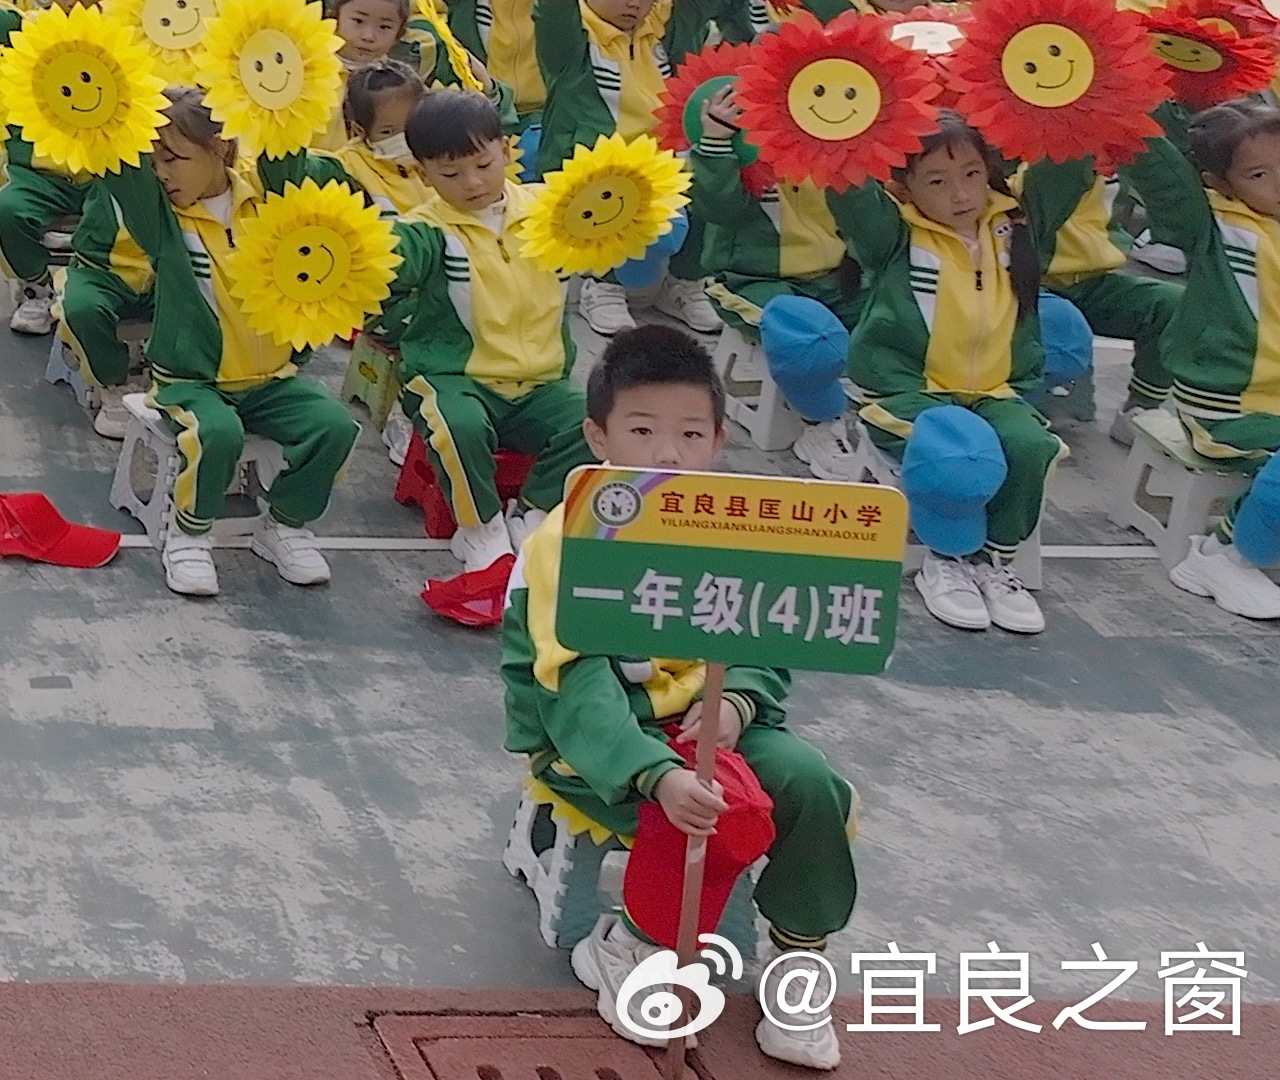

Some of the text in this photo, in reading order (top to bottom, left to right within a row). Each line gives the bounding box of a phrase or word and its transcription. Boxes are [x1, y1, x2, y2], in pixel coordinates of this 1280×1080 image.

[660, 491, 882, 528] 宜良县匡山小学
[660, 517, 879, 542] YILIANGXIANKUANGSHANXIAOXUE
[572, 568, 884, 646] 一年级(4)班
